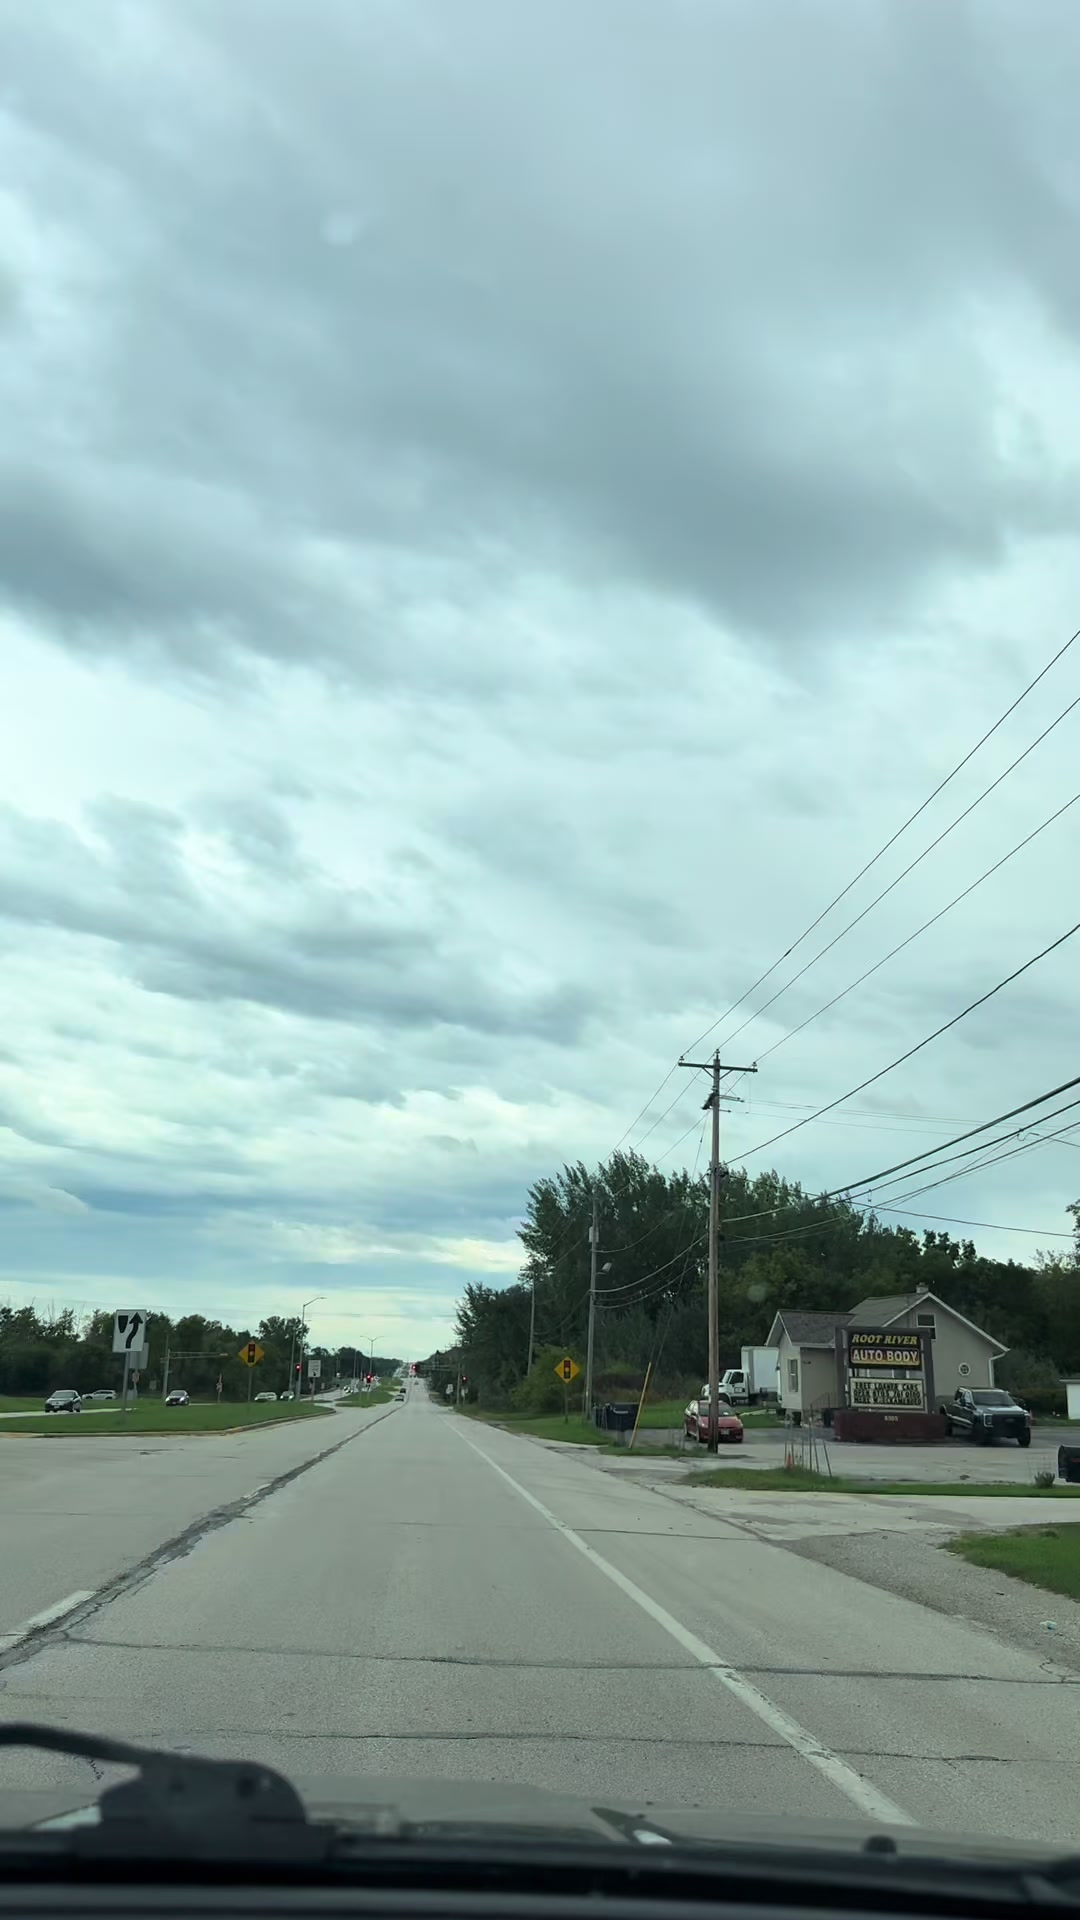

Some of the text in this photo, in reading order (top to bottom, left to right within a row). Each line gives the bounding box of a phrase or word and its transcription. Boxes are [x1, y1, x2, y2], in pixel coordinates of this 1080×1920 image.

[852, 1334, 918, 1345] ROOT RIVER
[853, 1349, 918, 1362] AUTO BODY
